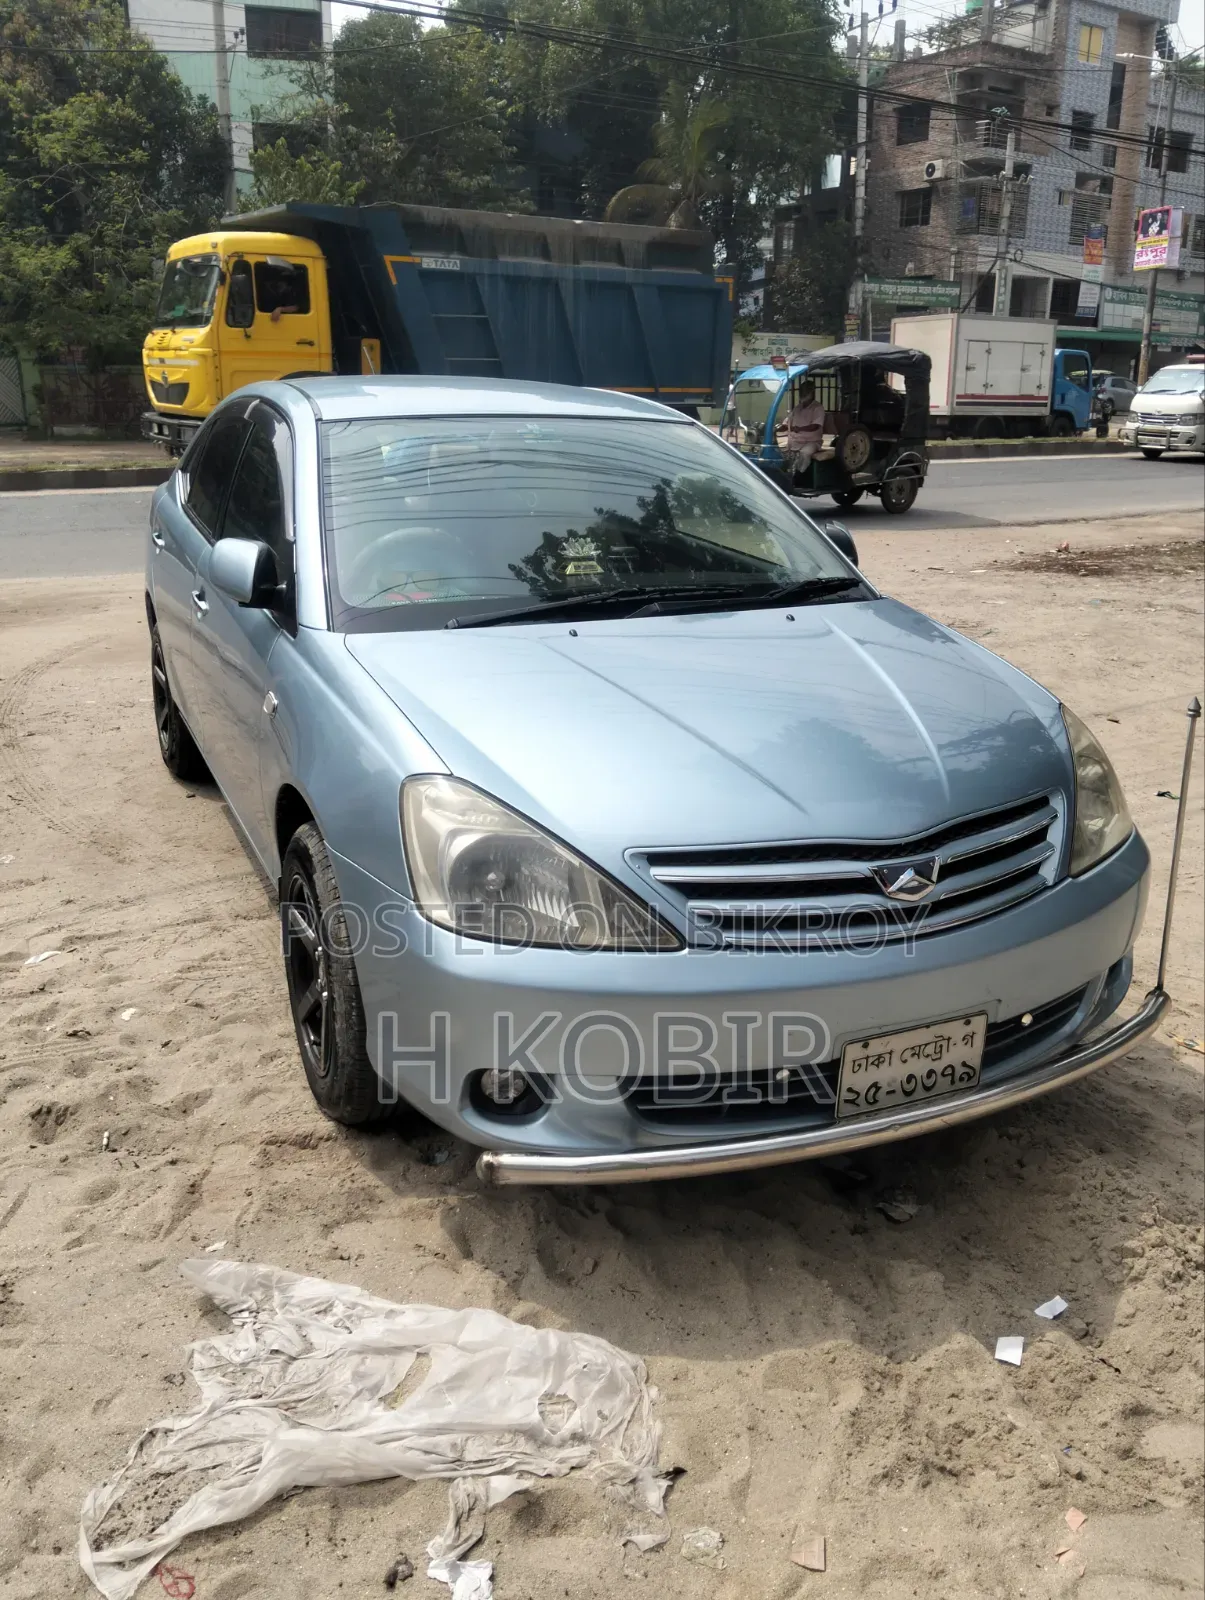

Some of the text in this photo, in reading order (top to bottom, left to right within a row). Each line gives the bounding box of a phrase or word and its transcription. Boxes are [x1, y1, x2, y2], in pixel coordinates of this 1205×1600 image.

[433, 259, 459, 269] TATA
[852, 1049, 894, 1074] ঢাকা
[843, 1060, 977, 1107] ২৫-৩৩৭৯
